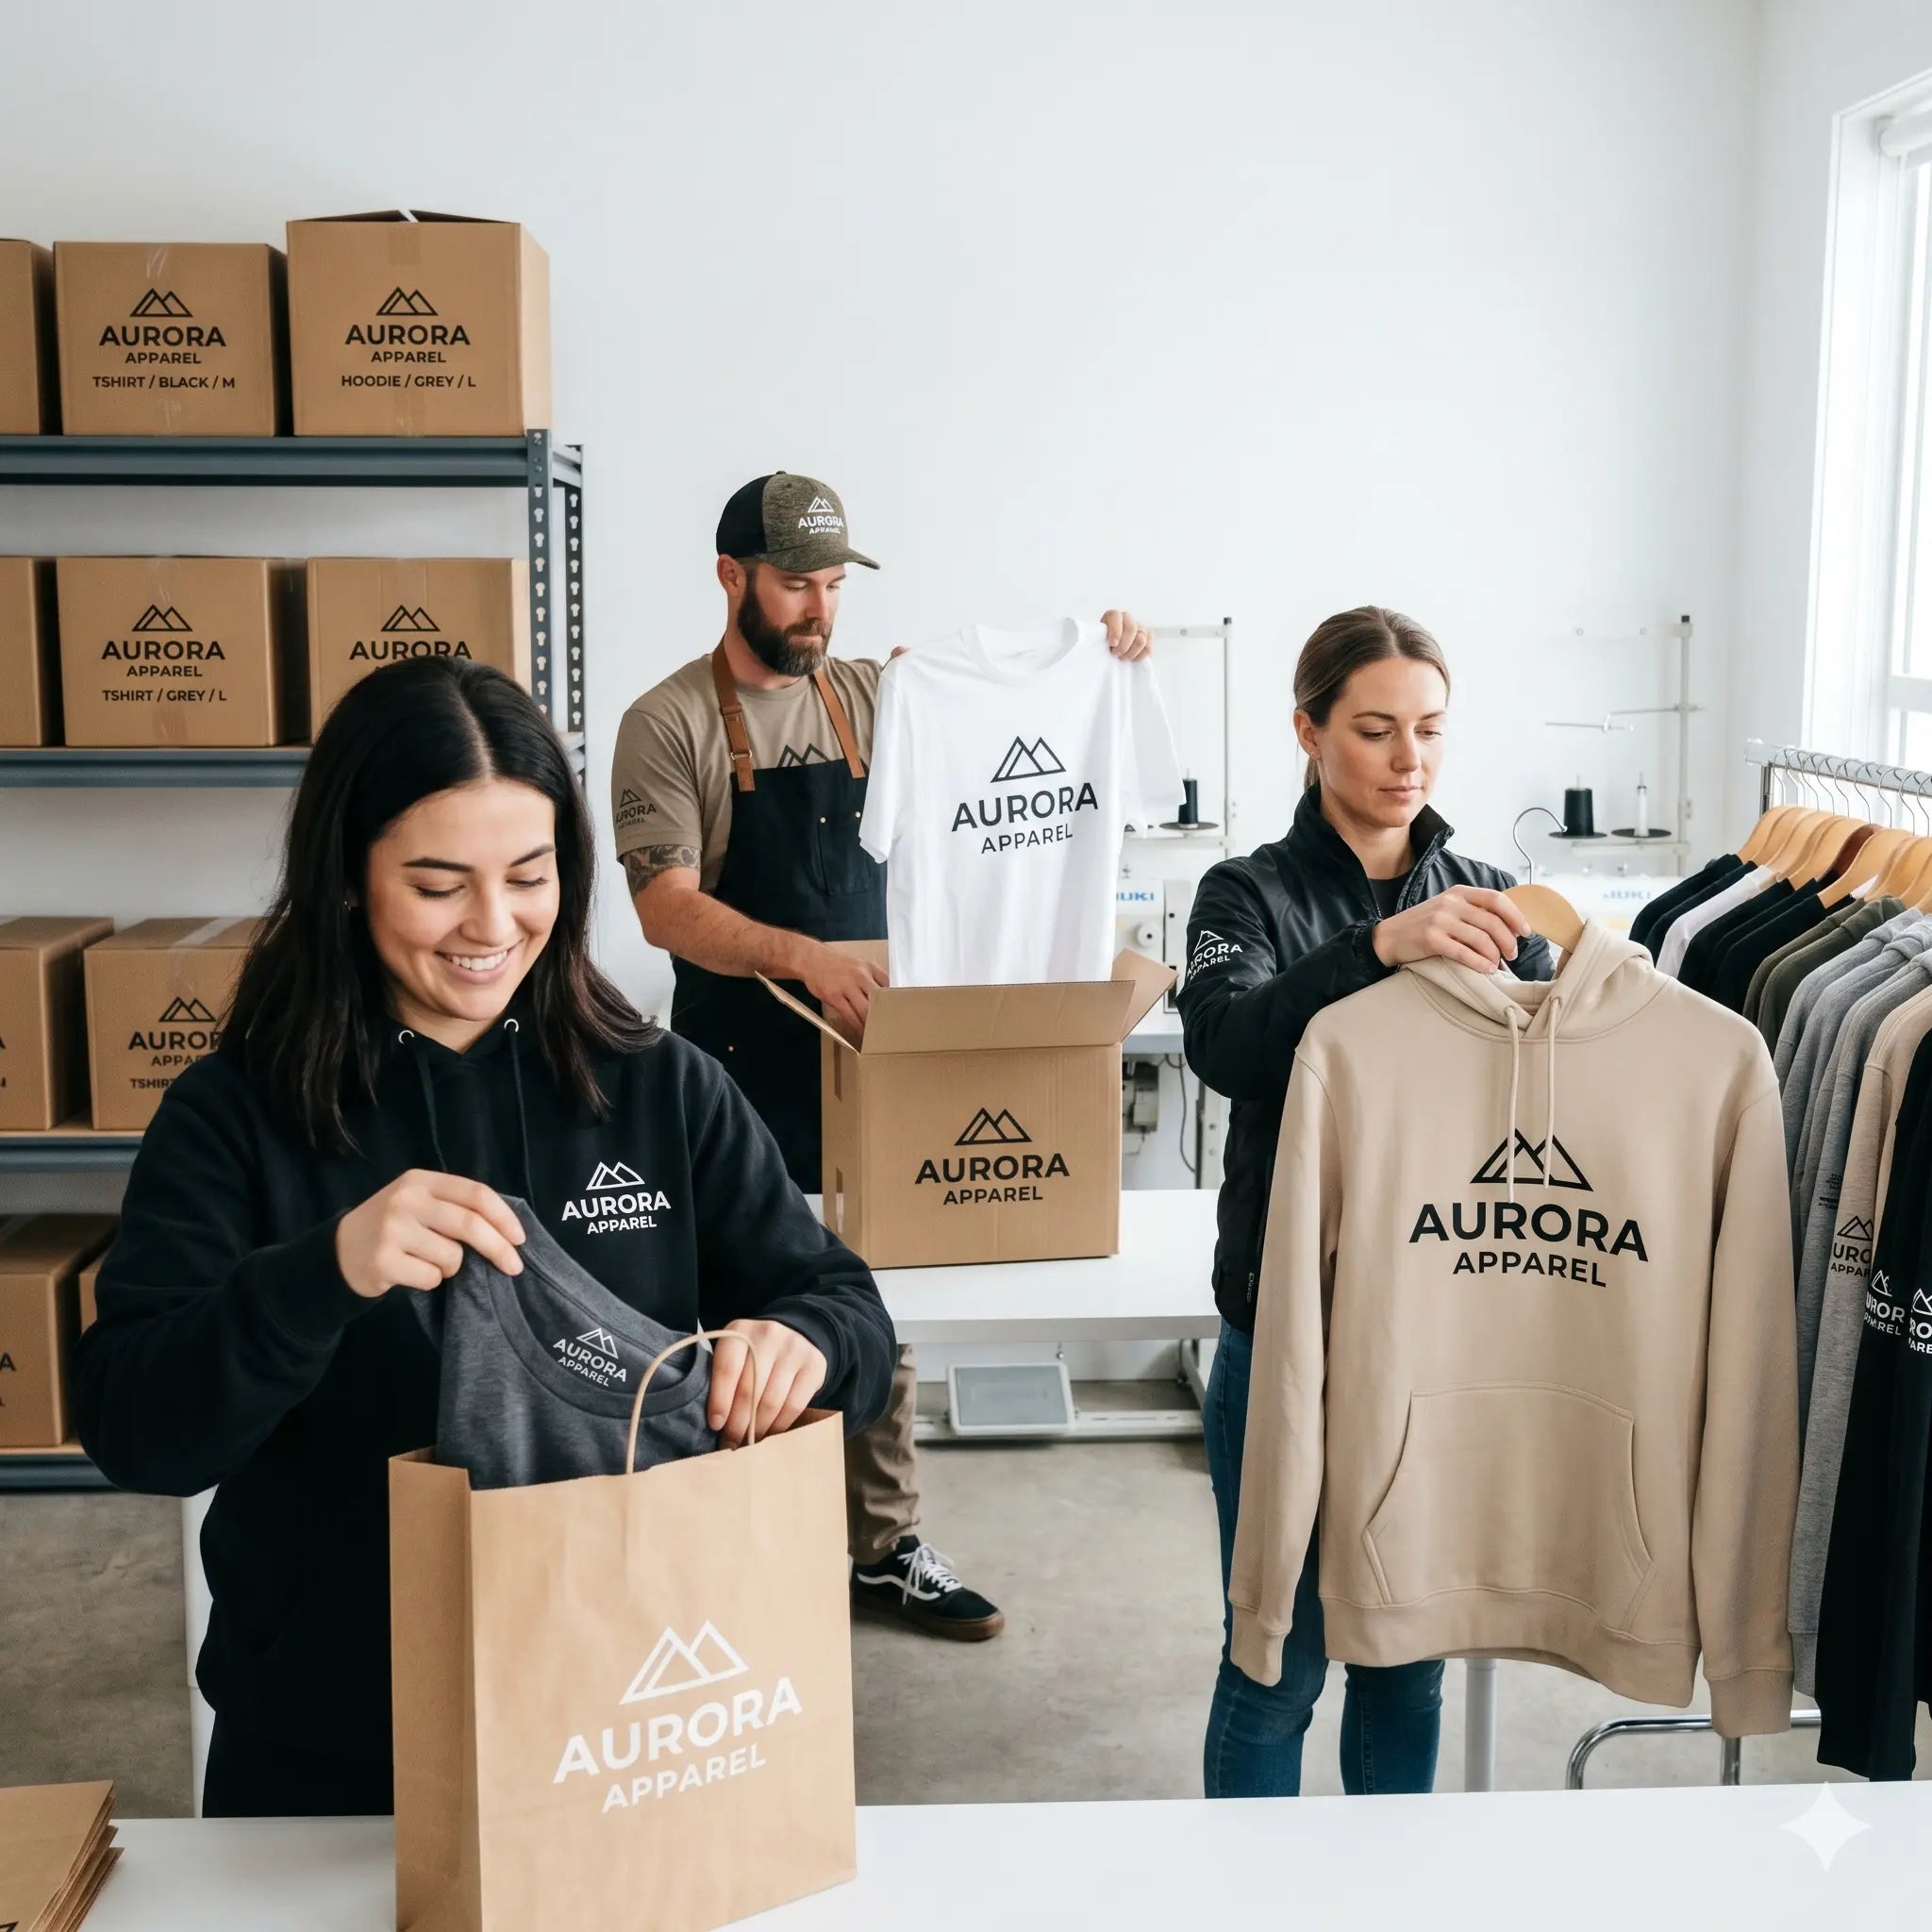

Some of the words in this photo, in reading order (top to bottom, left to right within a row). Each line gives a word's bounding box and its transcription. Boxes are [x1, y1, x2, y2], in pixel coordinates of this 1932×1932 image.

[99, 326, 226, 347] AURORA
[344, 325, 471, 345] AURORA
[125, 353, 202, 364] APPAREL
[371, 351, 446, 363] APPAREL
[92, 376, 145, 389] TSHIRT
[158, 376, 208, 389] BLACK
[223, 377, 235, 389] M
[341, 375, 402, 388] HOODIE
[414, 375, 455, 388] GREY
[467, 375, 476, 387] L
[101, 641, 225, 660] AURORA
[349, 641, 473, 660] AURORA
[126, 666, 203, 677] APPAREL
[103, 690, 154, 702] TSHIRT
[166, 690, 206, 702] GREY
[219, 690, 227, 702] L
[951, 782, 1098, 832] AURORA
[980, 823, 1074, 855] APPAREL
[914, 1153, 1071, 1185] AURORA
[943, 1186, 1043, 1206] APPAREL
[561, 1191, 672, 1222] AURORA
[587, 1215, 658, 1235] APPAREL
[1408, 1201, 1649, 1263] AURORA
[1452, 1251, 1607, 1289] APPAREL
[553, 1338, 627, 1383] AURORA
[558, 1356, 610, 1388] APPAREL
[553, 1675, 803, 1785] AURORA
[601, 1742, 768, 1815] APPAREL
